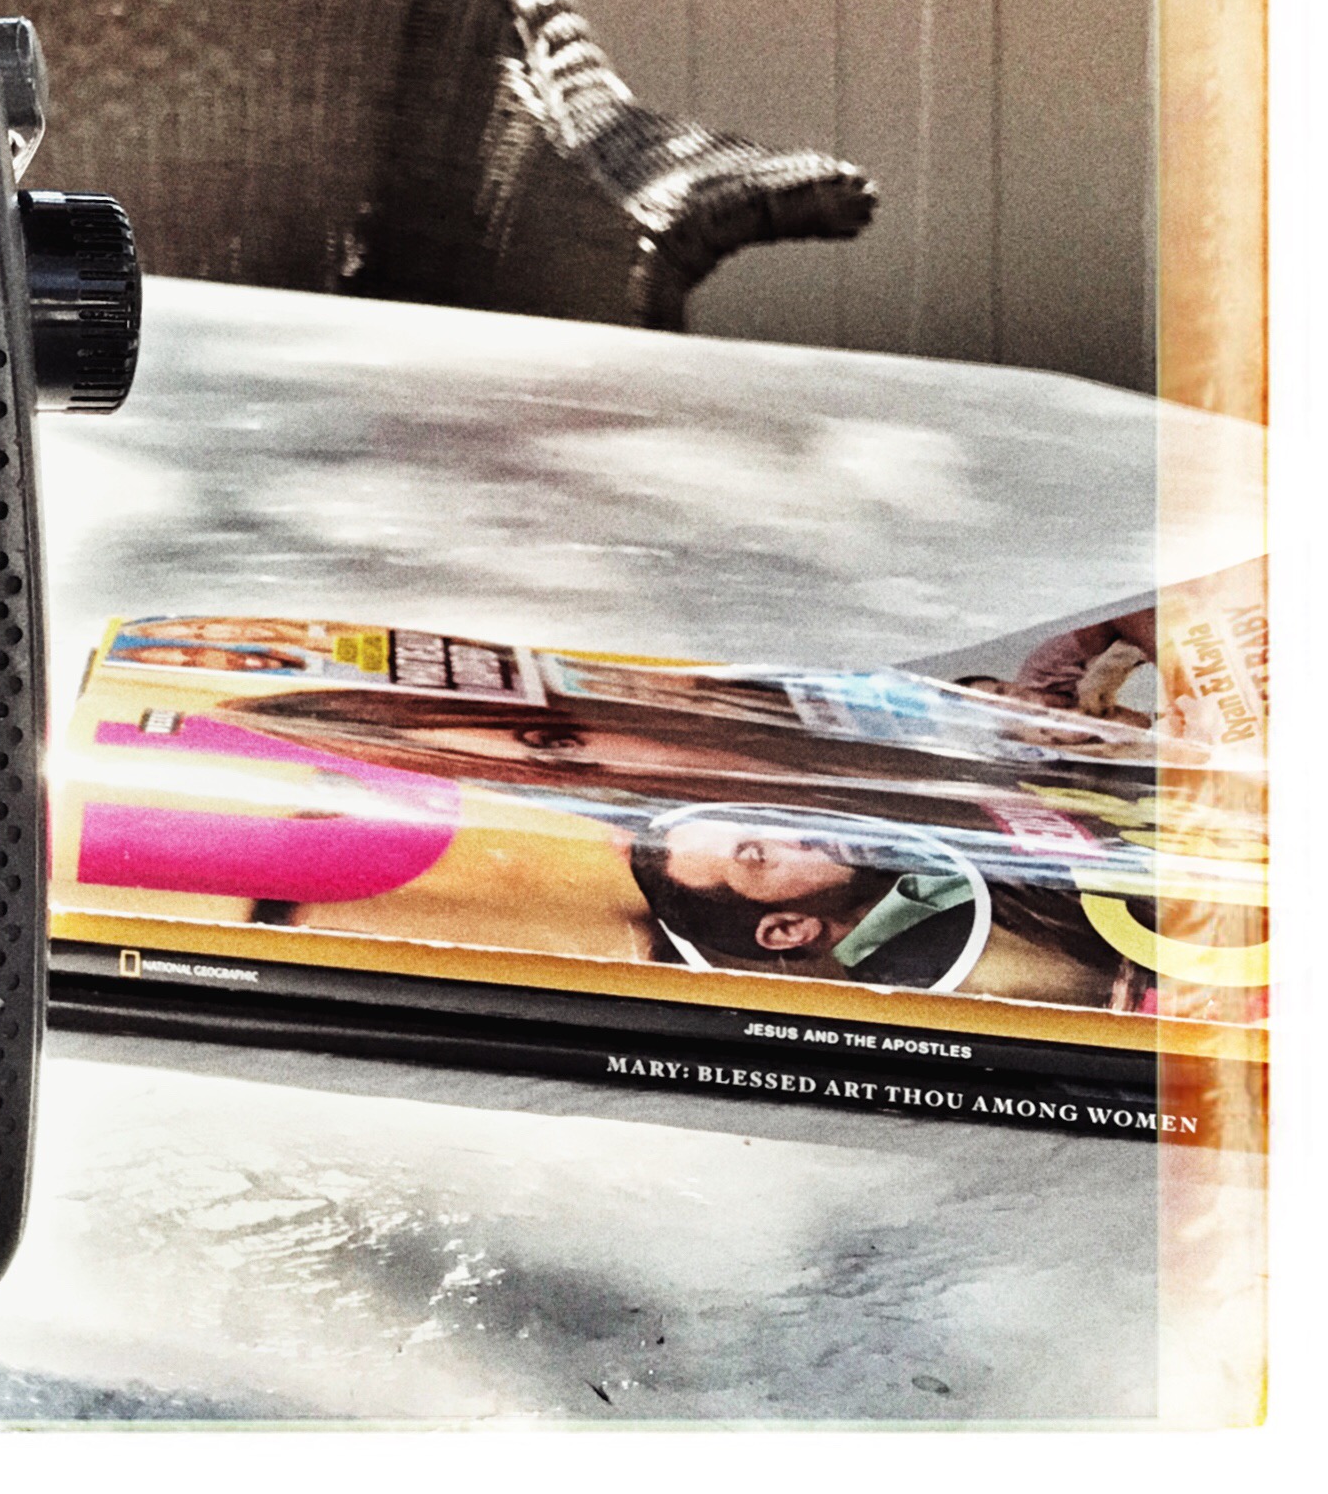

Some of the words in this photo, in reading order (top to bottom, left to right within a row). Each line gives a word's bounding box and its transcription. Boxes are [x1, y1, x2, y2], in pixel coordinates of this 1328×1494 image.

[1181, 623, 1226, 678] Kayla
[1217, 696, 1257, 744] Ryan
[142, 959, 193, 976] NATIONAL
[193, 964, 260, 983] GEOGRAPHIC
[744, 1022, 798, 1040] JESUS
[803, 1028, 840, 1045] AND
[843, 1032, 878, 1049] THE
[881, 1037, 973, 1059] APOSTLES
[606, 1056, 690, 1079] MARY:
[697, 1065, 817, 1093] BLESSED
[823, 1079, 878, 1101] ART
[884, 1085, 964, 1109] THOU
[972, 1096, 1079, 1122] AMONG
[1086, 1106, 1199, 1134] WOMEN
